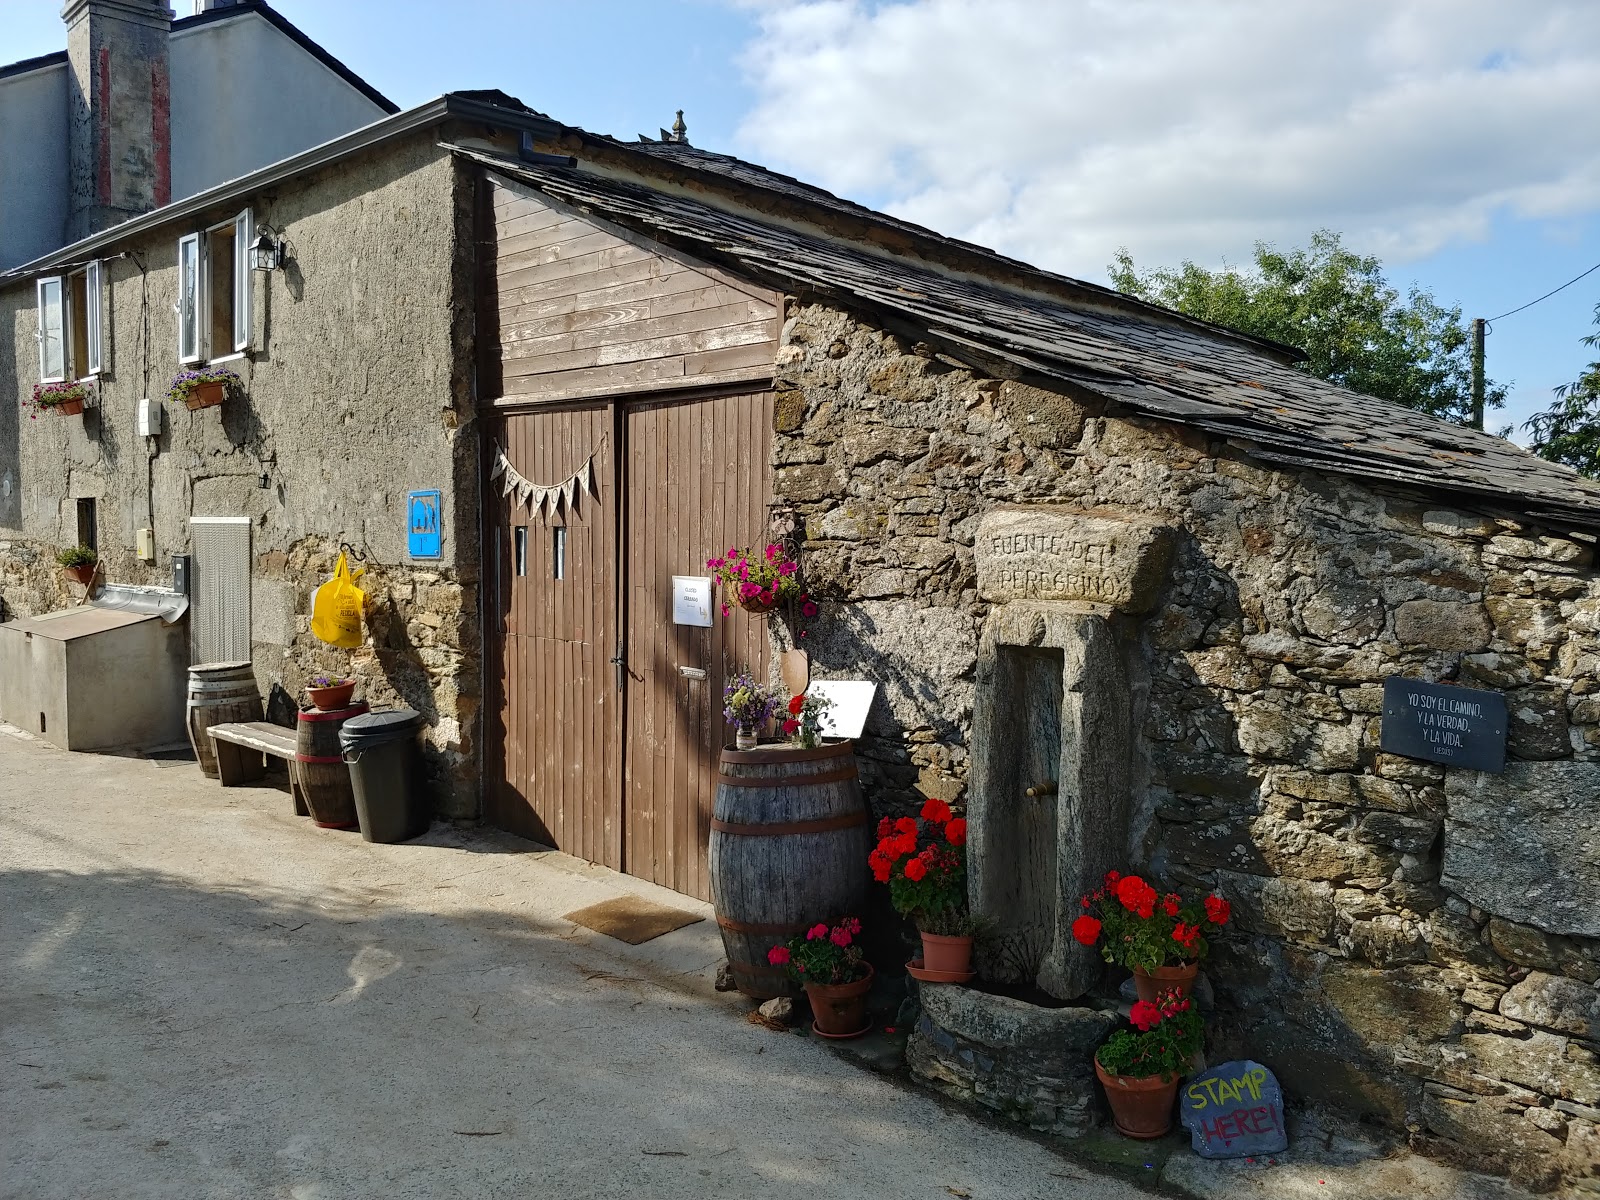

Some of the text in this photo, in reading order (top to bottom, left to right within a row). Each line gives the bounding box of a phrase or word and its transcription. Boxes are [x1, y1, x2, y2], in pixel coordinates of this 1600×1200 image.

[993, 533, 1062, 556] FUENTE
[1000, 570, 1118, 599] PEREGRINO
[1408, 692, 1483, 719] YO SOY EL CAMINO,
[1417, 710, 1471, 733] Y LA VERDAD,
[1422, 728, 1463, 748] Y LA VIDA.
[1188, 1068, 1266, 1109] STAMP
[1201, 1103, 1285, 1144] HERE!
